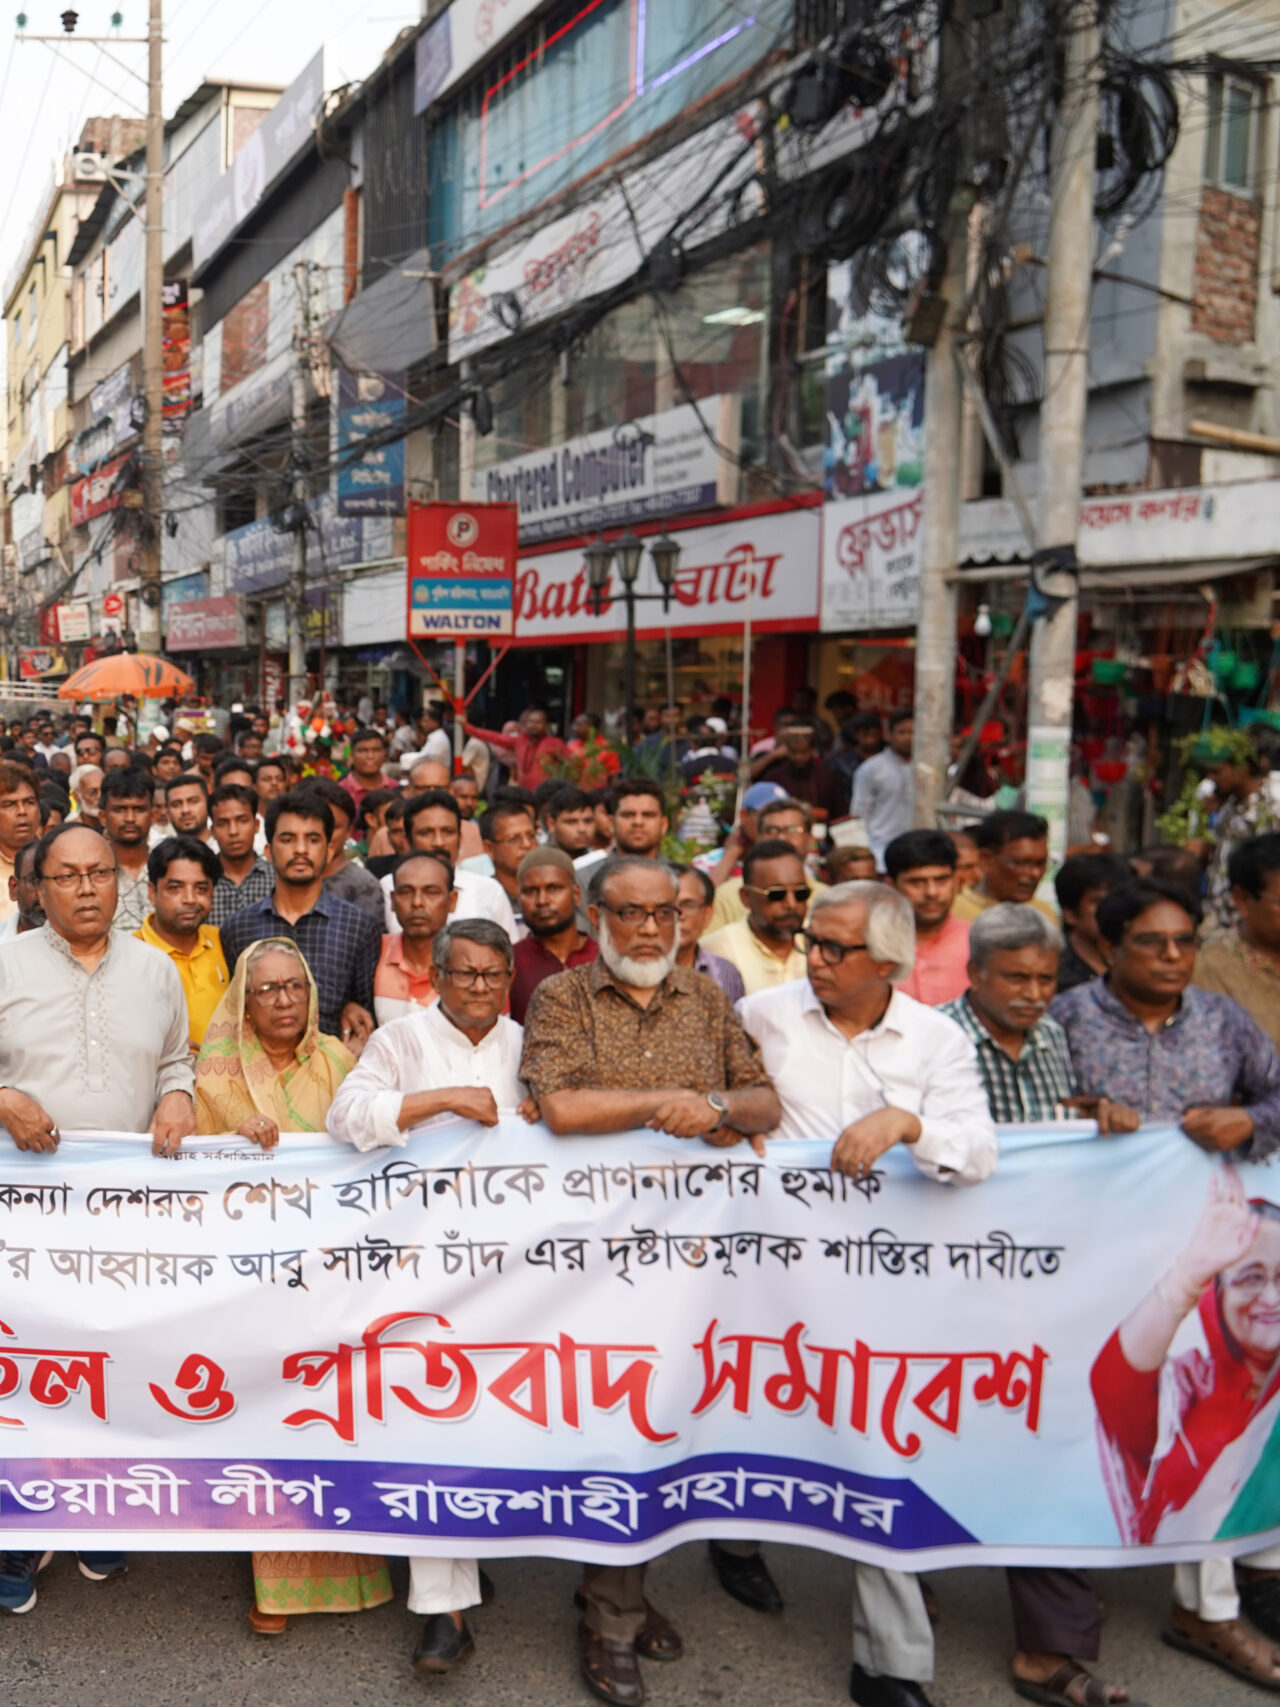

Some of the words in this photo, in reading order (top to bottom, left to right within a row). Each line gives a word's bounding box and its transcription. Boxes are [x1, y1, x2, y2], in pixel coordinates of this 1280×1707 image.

[487, 449, 557, 517] Chartered
[562, 433, 645, 504] Computer
[673, 543, 783, 606] বাটা
[423, 615, 500, 629] WALTON
[87, 1184, 208, 1226] দেশরত্ন
[224, 1176, 319, 1222] শেখ
[333, 1161, 548, 1216] হাসিনাকে
[563, 1160, 764, 1203] প্রাণনাশের
[45, 1246, 217, 1290] আহ্বায়ক
[227, 1249, 308, 1292] আবু
[320, 1234, 425, 1281] সাঈদ
[436, 1230, 508, 1278] চাঁদ
[526, 1238, 590, 1272] এর
[603, 1223, 807, 1286] দৃষ্টান্তমূলক
[818, 1228, 933, 1276] শাস্তির
[945, 1230, 1065, 1280] দাবীতে
[147, 1352, 237, 1424] ও
[282, 1310, 680, 1445] প্রতিবাদ
[690, 1318, 1050, 1460] সমাবেশ
[205, 1463, 352, 1526] লীগ,
[372, 1475, 648, 1536] রাজশাহী
[658, 1466, 903, 1536] মহানগর
